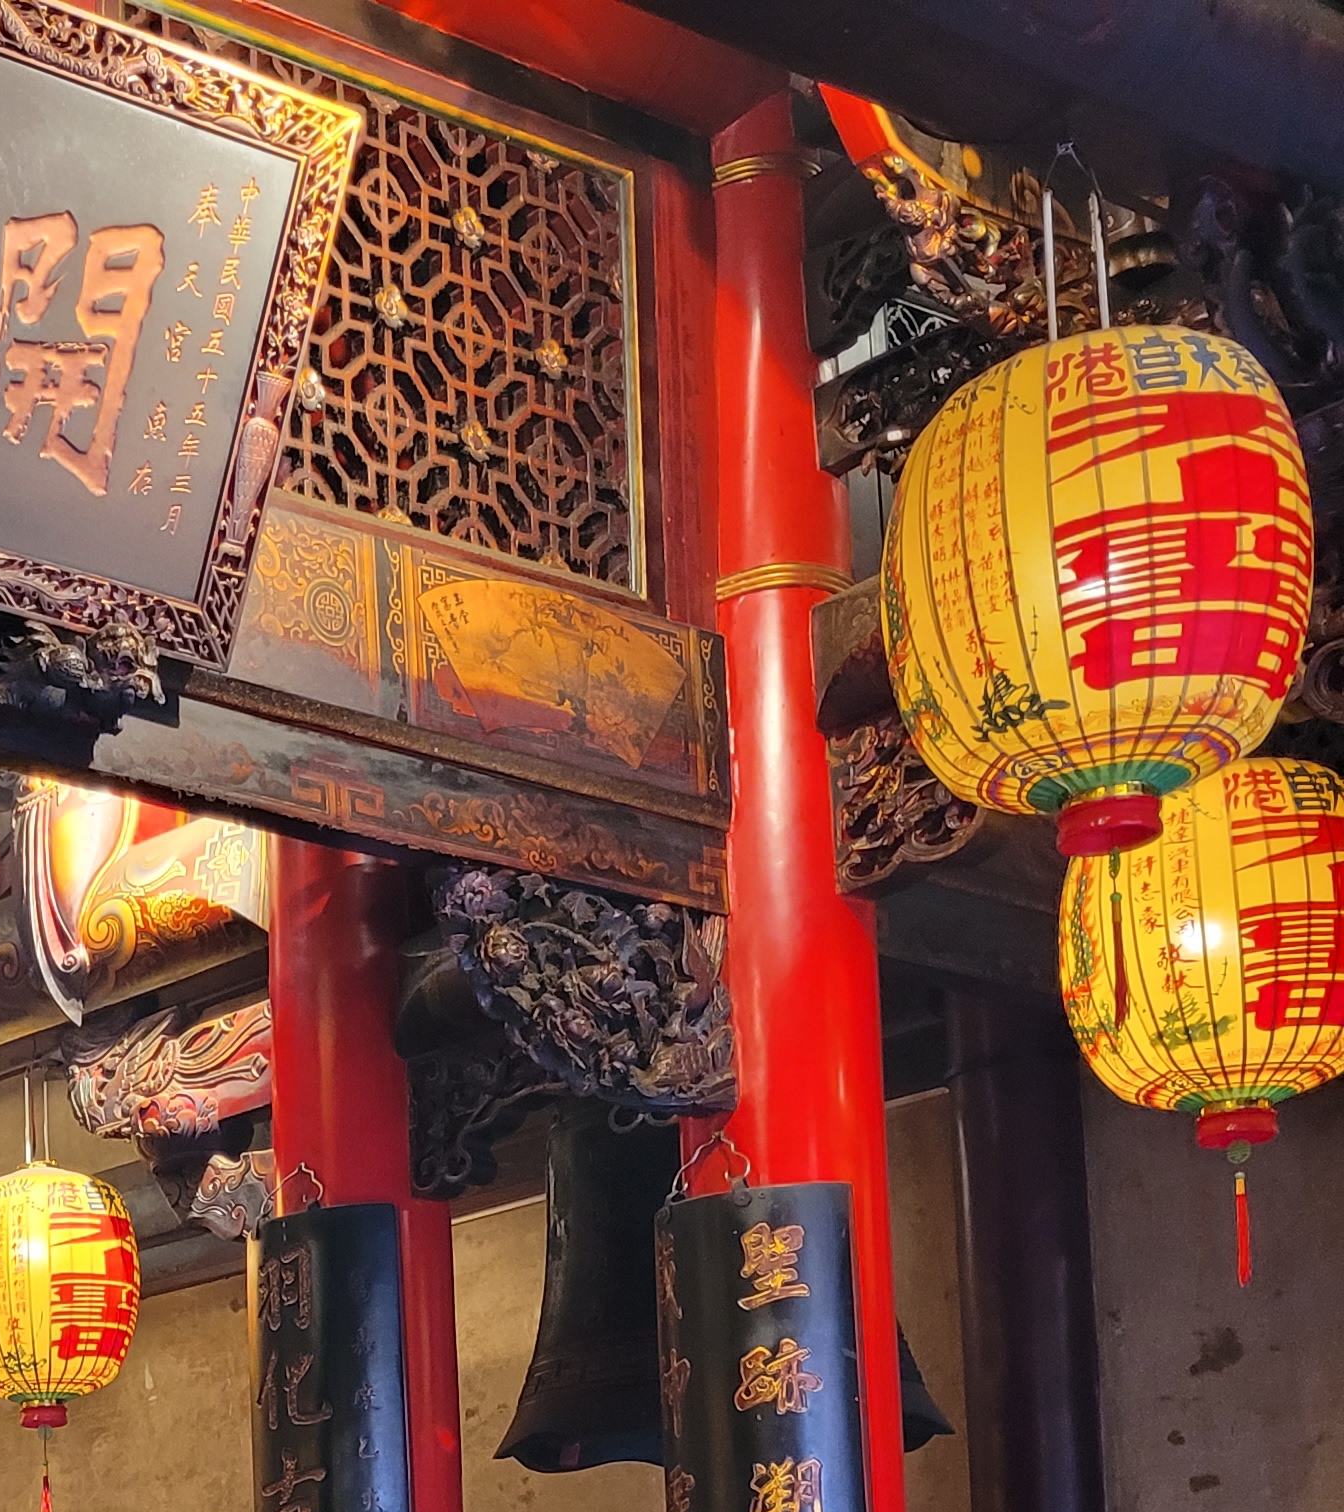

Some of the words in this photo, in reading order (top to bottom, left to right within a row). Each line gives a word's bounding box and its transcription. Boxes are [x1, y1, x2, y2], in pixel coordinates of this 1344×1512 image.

[159, 176, 261, 536] 中華民國五十五年三月
